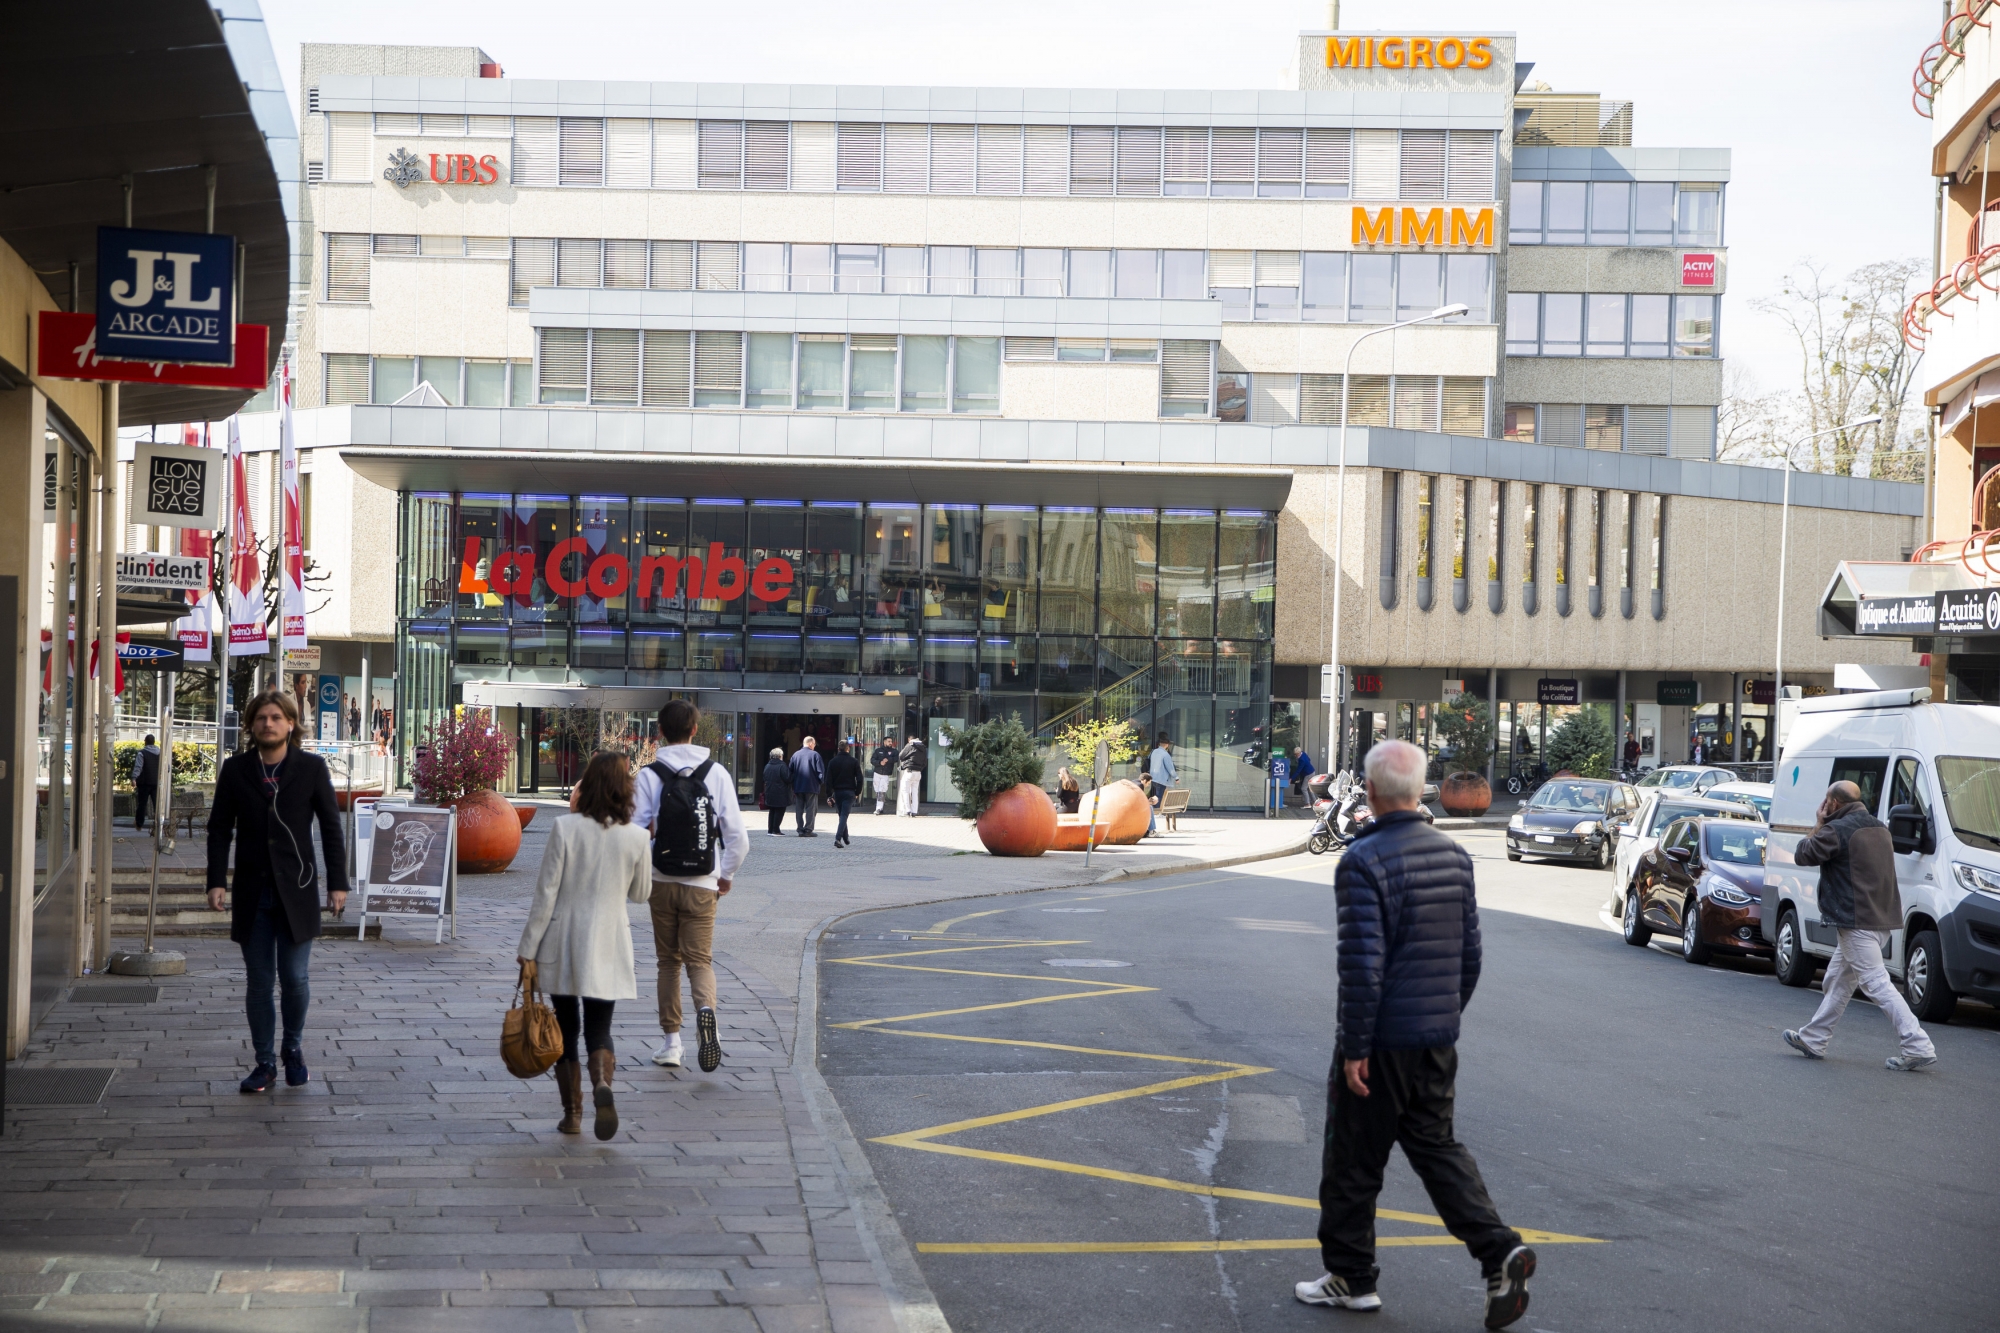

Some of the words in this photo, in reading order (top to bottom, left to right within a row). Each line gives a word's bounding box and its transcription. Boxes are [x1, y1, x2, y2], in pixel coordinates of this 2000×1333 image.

[1325, 36, 1493, 69] MIGROS
[428, 153, 498, 185] UBS
[1351, 206, 1494, 247] MMM
[1683, 261, 1714, 271] ACTIV
[109, 249, 220, 311] J&L
[108, 312, 219, 337] ARCADE
[117, 575, 145, 584] Clinique
[146, 577, 174, 585] dentaire
[184, 579, 202, 587] Nyon
[545, 537, 793, 603] Combe
[1858, 602, 1889, 630] Optique
[1889, 602, 1899, 625] et
[1939, 593, 1984, 621] Acuitis
[119, 648, 158, 656] DOZ
[1356, 675, 1383, 692] UBS
[1549, 684, 1575, 693] Boutique
[1274, 762, 1284, 773] 20
[694, 796, 708, 850] Supreme
[381, 885, 400, 894] Votre
[401, 886, 428, 895] Barbier
